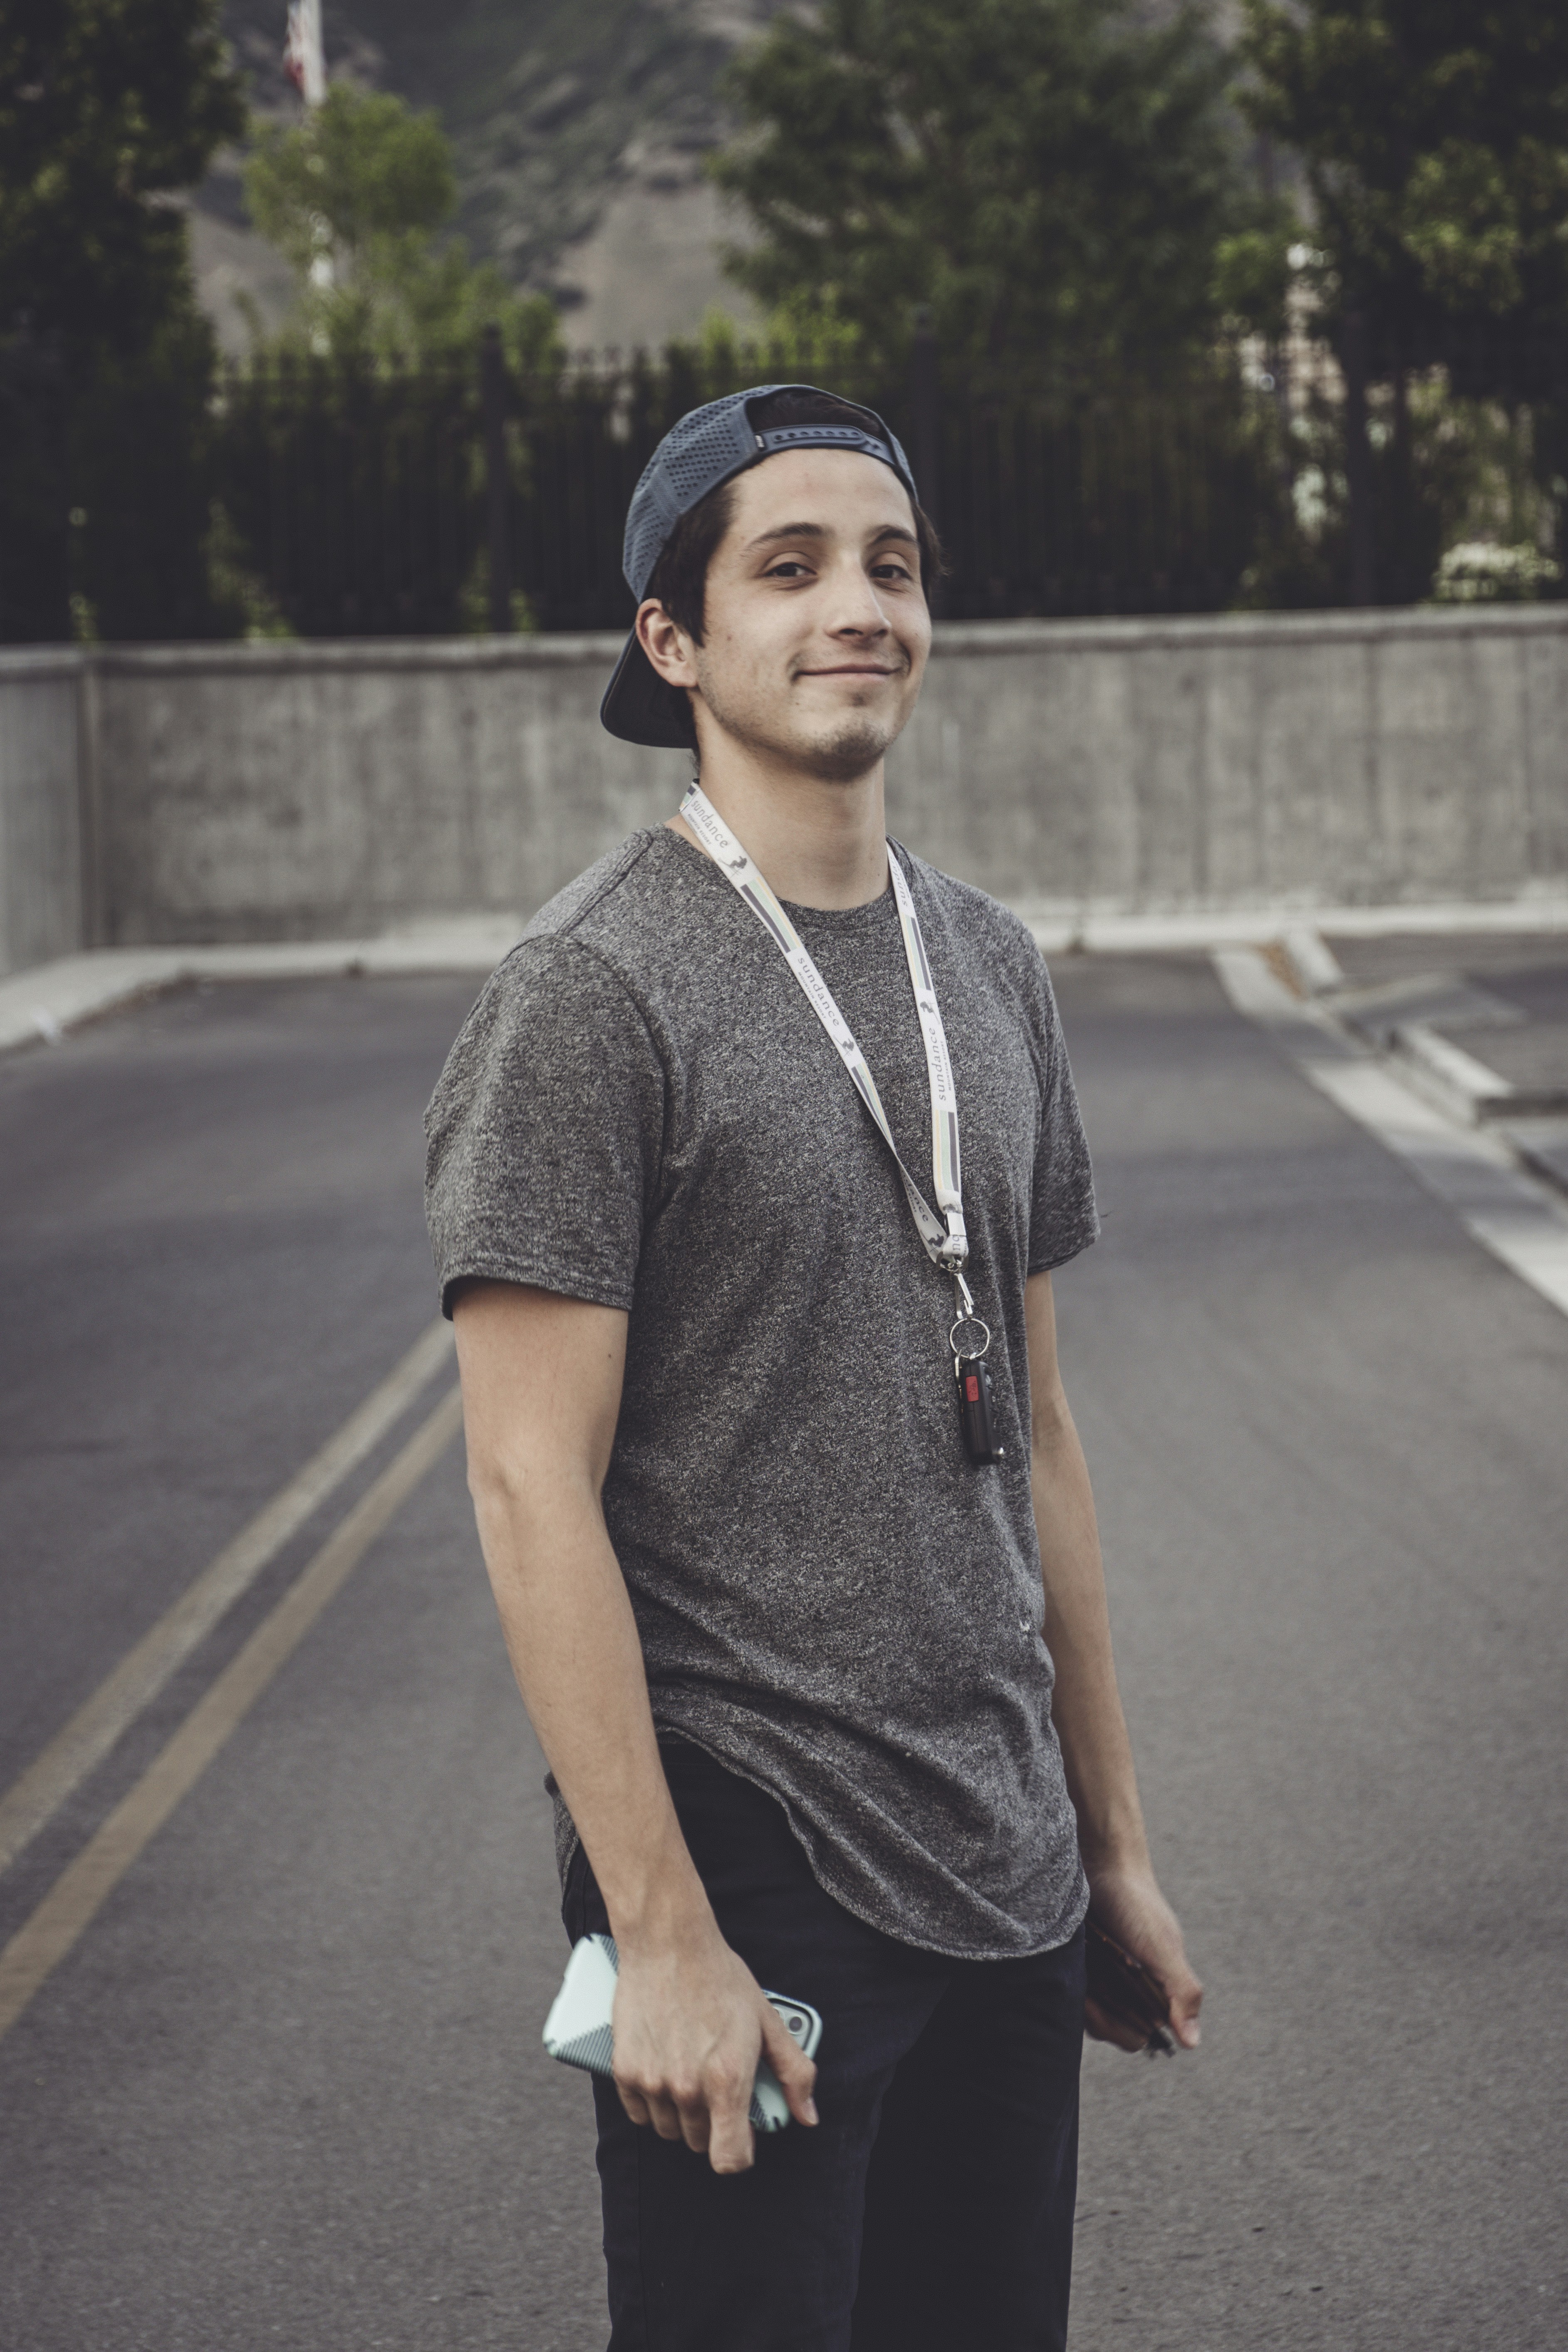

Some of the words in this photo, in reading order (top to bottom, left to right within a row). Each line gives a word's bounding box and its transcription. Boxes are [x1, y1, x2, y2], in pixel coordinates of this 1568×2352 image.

[691, 801, 728, 848] sundance
[798, 957, 839, 1026] sundance
[798, 972, 815, 999] MOUNTAIN
[814, 1000, 827, 1019] RESORT
[929, 1028, 946, 1101] sundance
